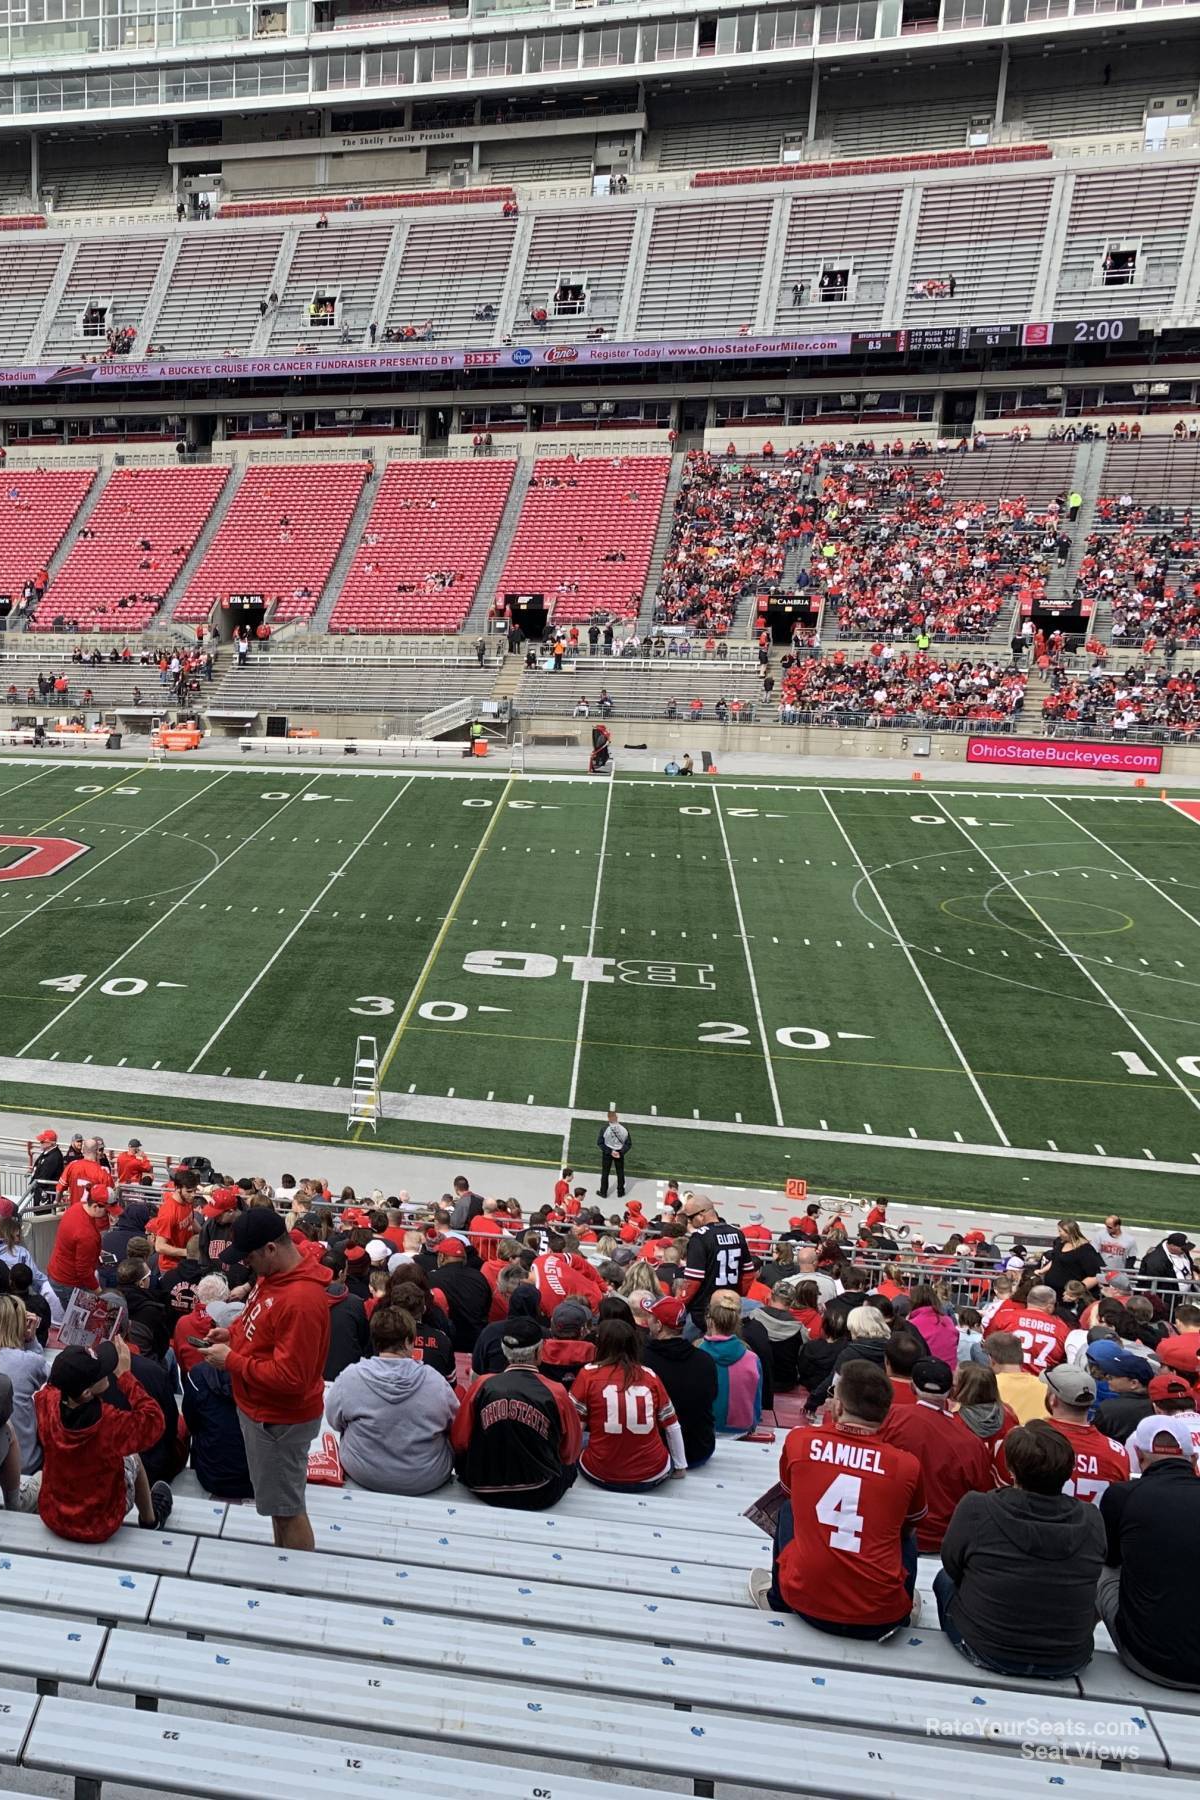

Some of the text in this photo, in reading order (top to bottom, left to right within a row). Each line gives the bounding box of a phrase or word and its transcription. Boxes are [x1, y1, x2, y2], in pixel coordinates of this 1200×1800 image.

[342, 132, 455, 147] The Shelly Family Pressbox
[986, 335, 1000, 344] 5.1
[1074, 320, 1124, 342] 2:00
[463, 352, 501, 365] BEEF
[590, 340, 838, 361] Register Today! www.OhioStateFourMiler.com
[99, 364, 149, 376] BUCKEYE
[159, 355, 456, 375] A BUCKEYE CRUISE FOR CANCER FUNDRAISER PRESENTED BY
[0, 372, 37, 382] Stadium
[971, 743, 1159, 767] OhioStateBuckeyes.com
[39, 973, 149, 996] 40
[348, 995, 469, 1022] 30
[697, 1021, 831, 1051] 20
[787, 1180, 805, 1196] 20
[716, 1232, 740, 1245] ELLIOTT
[715, 1248, 742, 1286] 15
[1018, 1316, 1057, 1334] GEORGE
[425, 1338, 438, 1349] JR.
[480, 1398, 551, 1441] OHIO STATE
[602, 1385, 656, 1435] 10
[809, 1438, 885, 1475] SAMUEL
[815, 1472, 864, 1554] 4
[163, 1731, 179, 1740] 22
[347, 1759, 361, 1768] 21
[533, 1788, 551, 1799] 20
